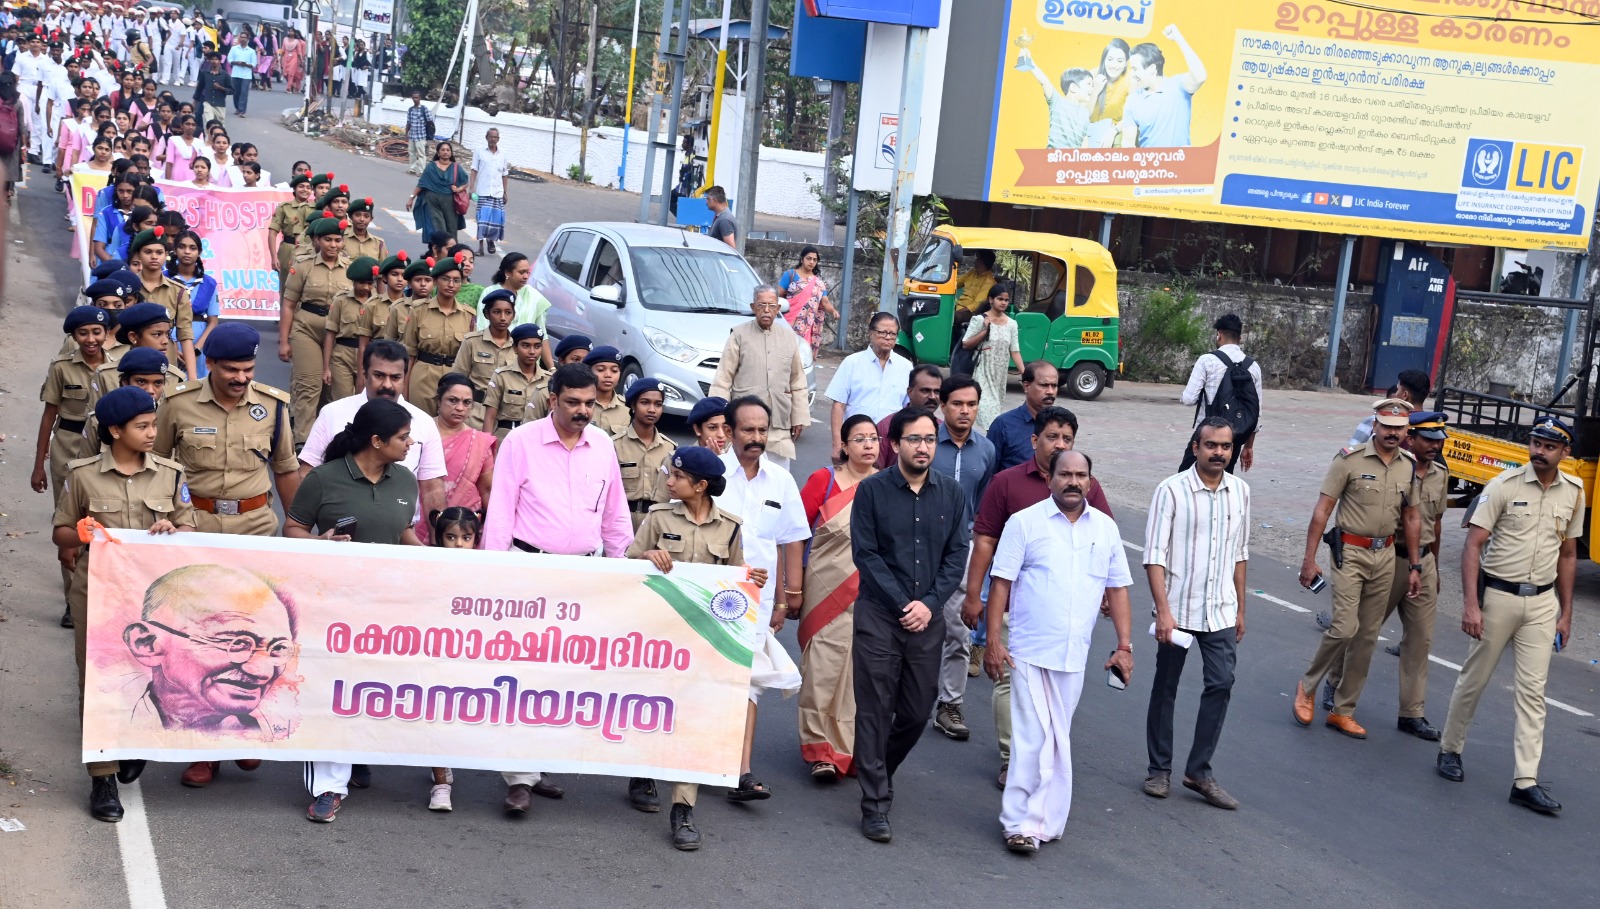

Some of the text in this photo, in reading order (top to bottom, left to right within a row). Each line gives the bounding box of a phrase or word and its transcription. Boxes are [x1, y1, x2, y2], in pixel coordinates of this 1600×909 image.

[1274, 2, 1571, 48] ഉറപ്പുള്ള കാരണം
[1323, 44, 1430, 69] തിരഞ്ഞെടുക്കാവുന്ന
[1311, 67, 1381, 85] ഇൻഷുറൻസ്
[1381, 73, 1425, 88] പരിരക്ഷ
[1257, 86, 1287, 96] വർഷം
[1332, 93, 1362, 103] വർഷം
[1317, 141, 1374, 152] ഇൻഷുറൻസ്
[1047, 149, 1185, 166] ജീവിതകാലം മുഴുവൻ
[1056, 169, 1178, 184] ഉറപ്പുള്ള വരുമാനം.
[1515, 148, 1574, 191] LIC
[1354, 197, 1410, 210] LIC India Forever
[1505, 204, 1545, 212] CORPORATION
[201, 238, 215, 259] &
[1408, 257, 1429, 271] Air
[1428, 284, 1443, 292] AIR
[450, 596, 581, 621] ജനുവരി 30
[326, 622, 691, 671] രക്തസാക്ഷിത്വദിനം
[331, 675, 675, 742] ശാന്തിയാത്ര
